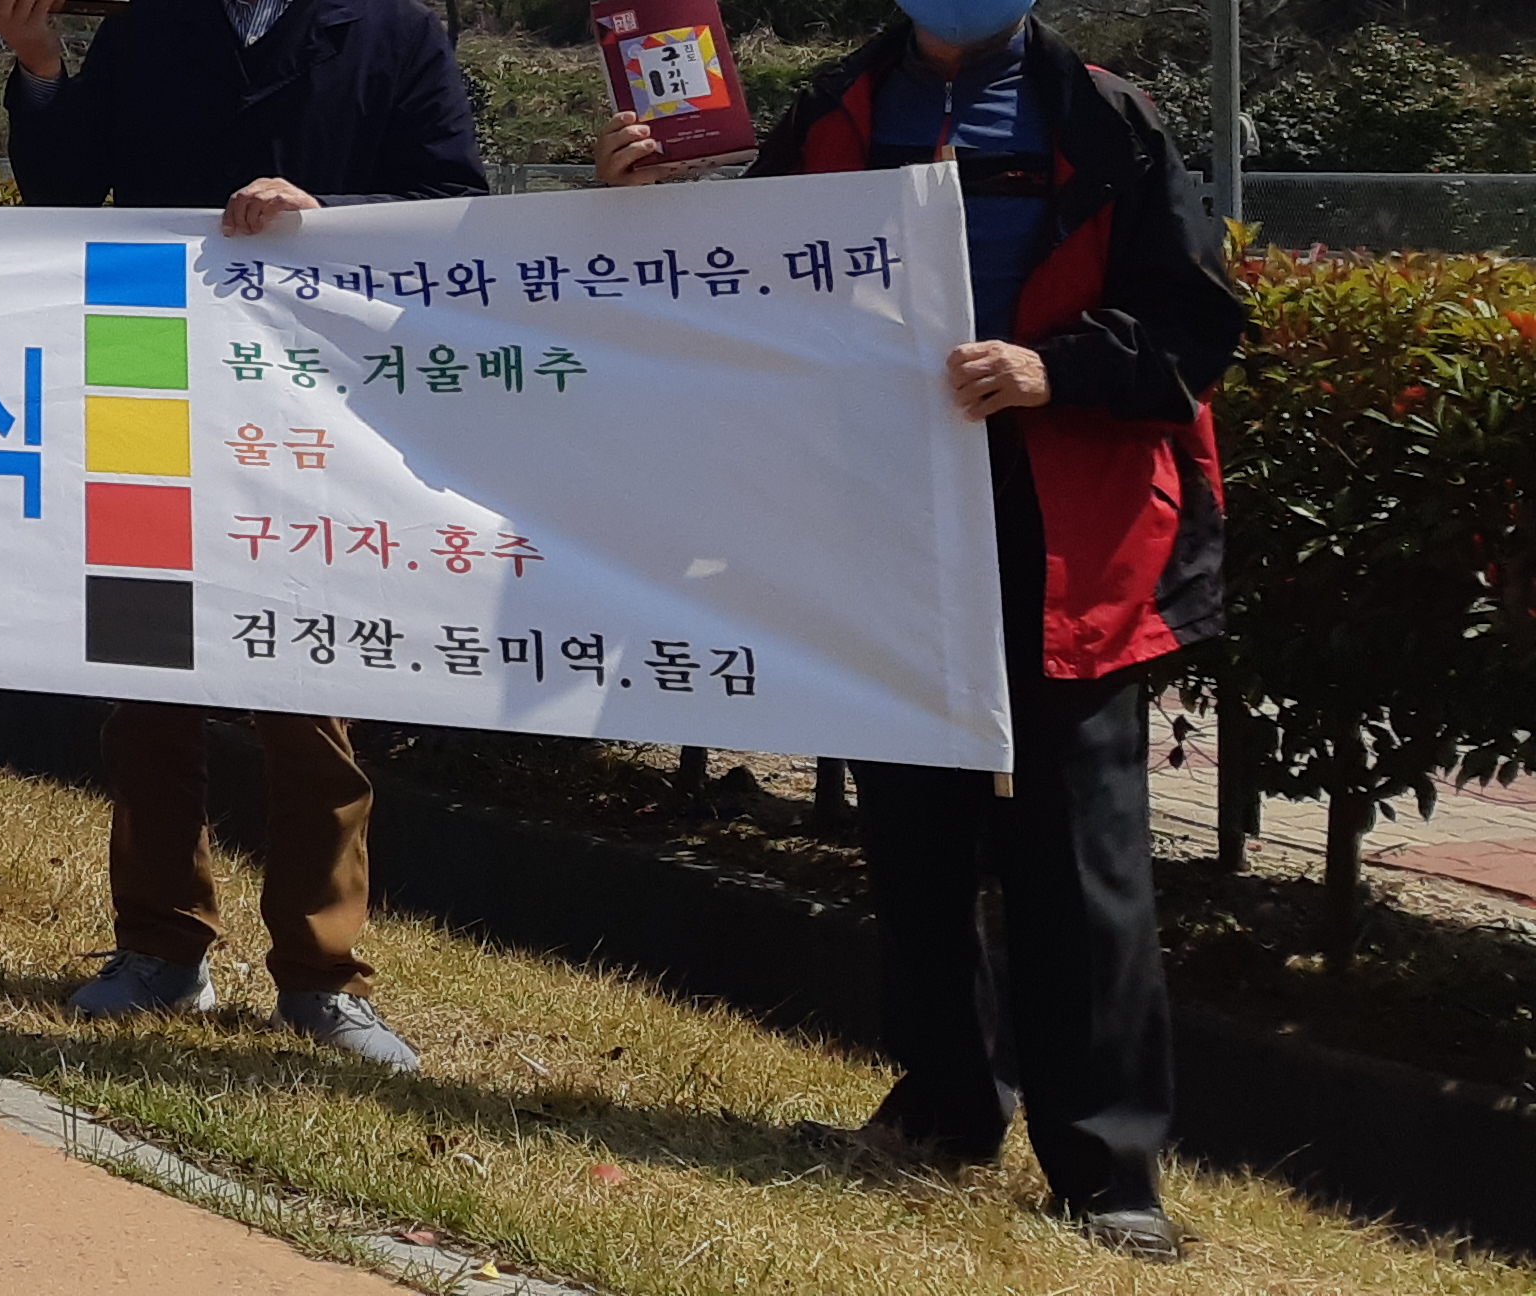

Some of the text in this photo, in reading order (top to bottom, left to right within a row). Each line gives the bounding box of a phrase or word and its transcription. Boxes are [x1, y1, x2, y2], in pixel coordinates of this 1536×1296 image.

[659, 45, 690, 97] 구기자
[219, 258, 496, 308] 청정바다와
[224, 423, 336, 472] 울금
